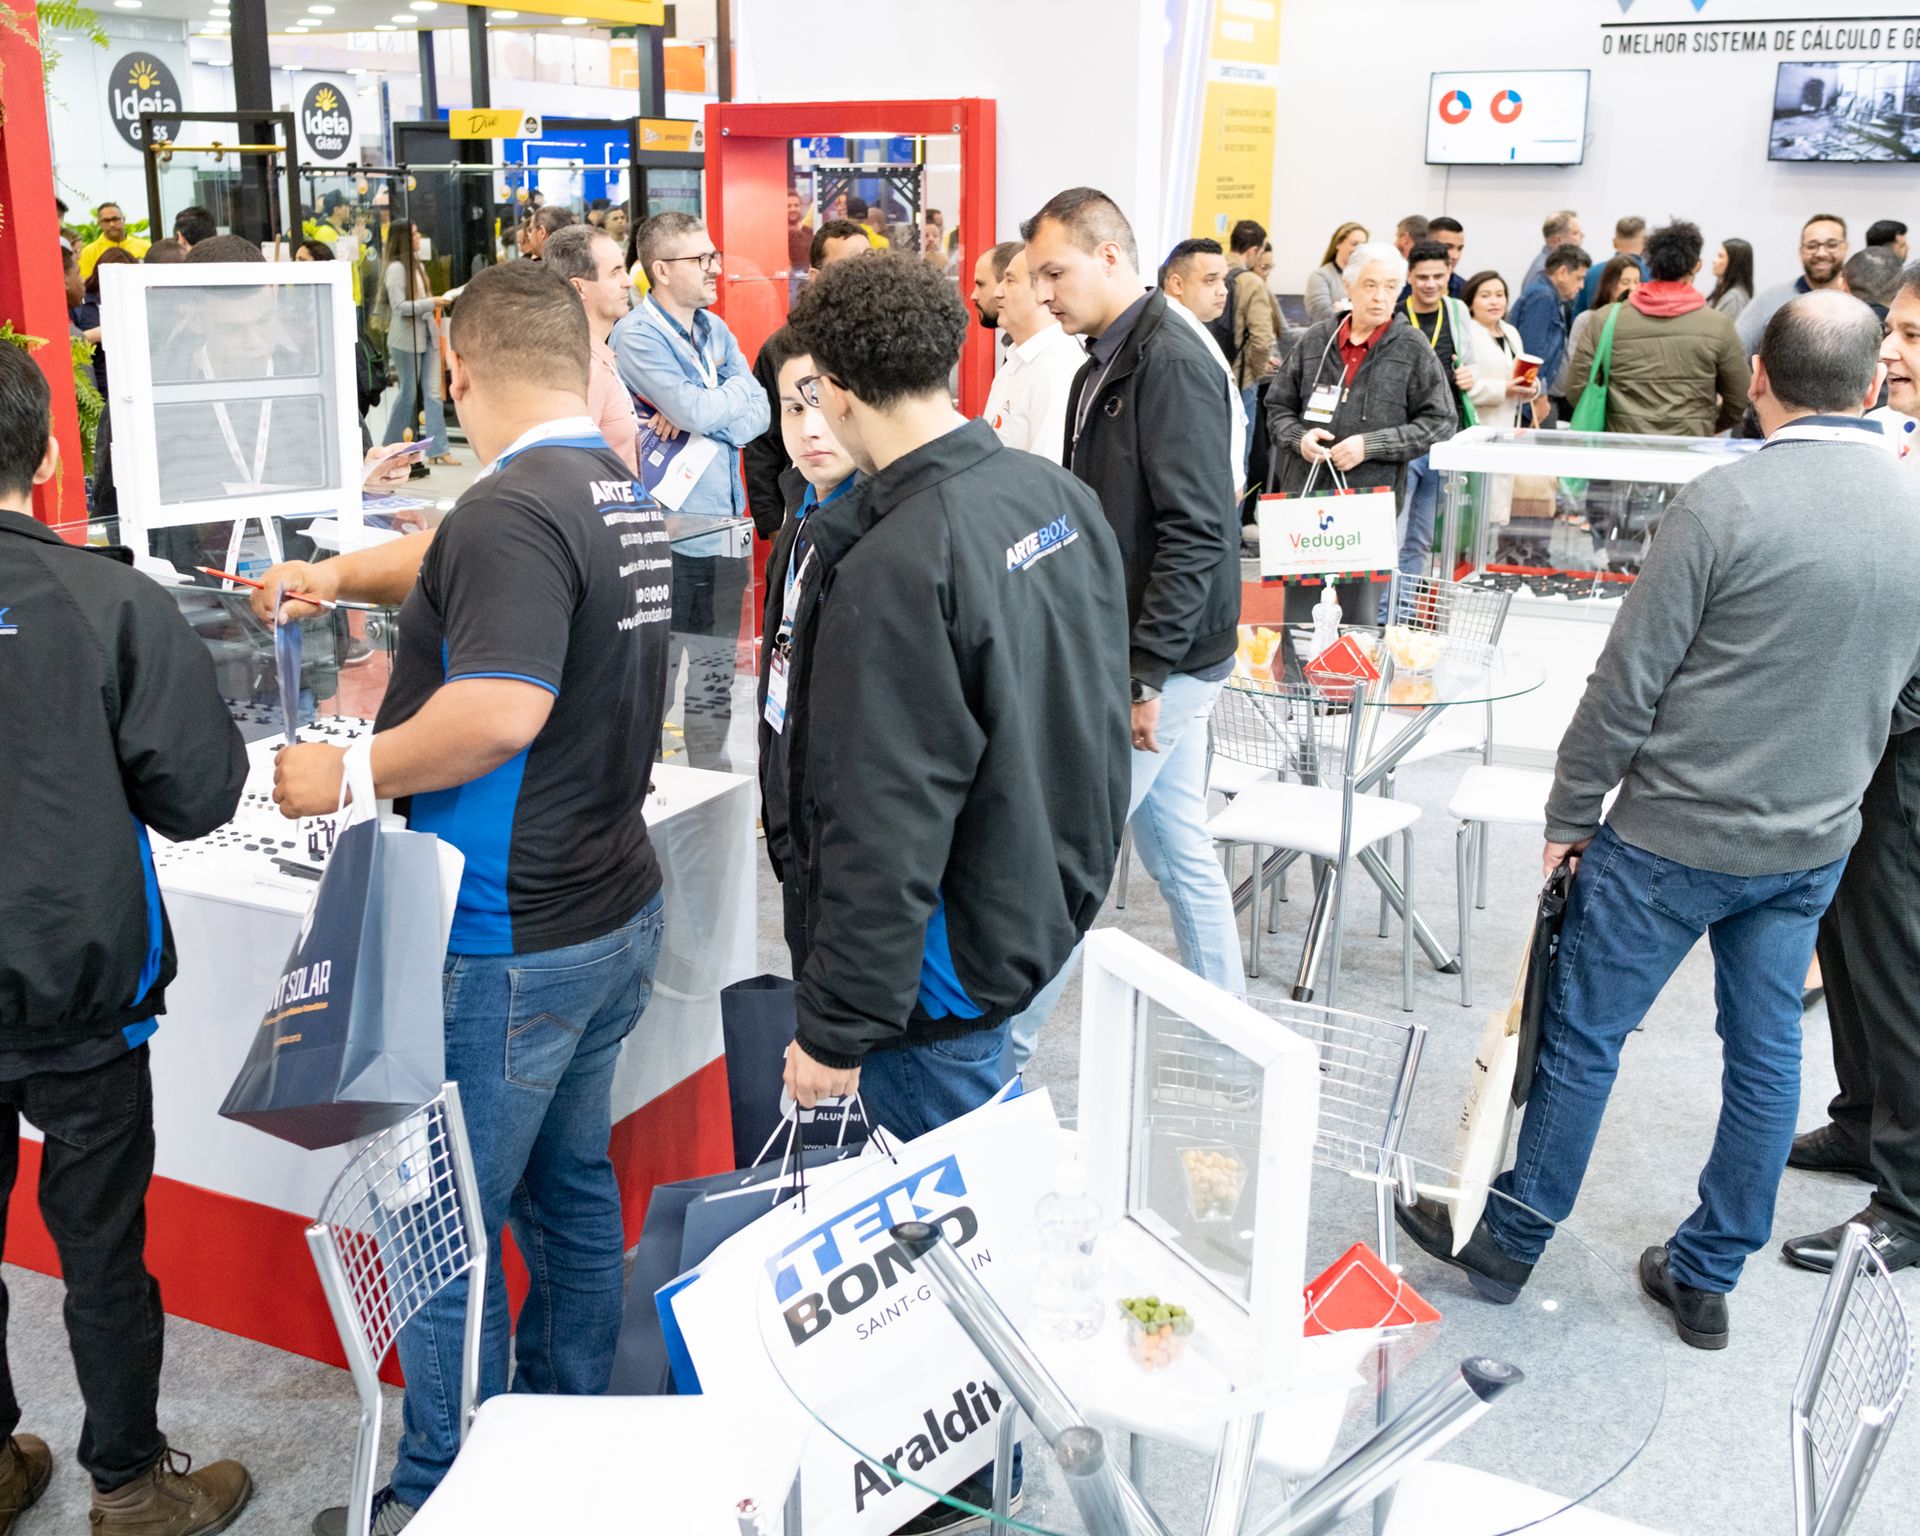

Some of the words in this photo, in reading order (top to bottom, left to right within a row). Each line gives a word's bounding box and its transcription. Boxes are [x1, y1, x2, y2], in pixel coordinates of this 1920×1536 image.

[1603, 35, 1613, 54] O
[1618, 33, 1687, 54] MELHOR
[1692, 30, 1767, 52] SISTEMA
[1774, 30, 1796, 51] DE
[1801, 25, 1881, 50] CÁLCULO
[1887, 28, 1897, 49] E
[114, 88, 176, 119] Ideia
[130, 121, 168, 141] Gss
[305, 109, 349, 136] Ideia
[315, 135, 342, 150] Glass
[1290, 531, 1361, 550] Vedugal
[816, 1112, 861, 1122] ALUMNI
[774, 1165, 946, 1290] TEK
[856, 1249, 992, 1340] SAINT-GIN
[854, 1380, 1001, 1514] Araldit
